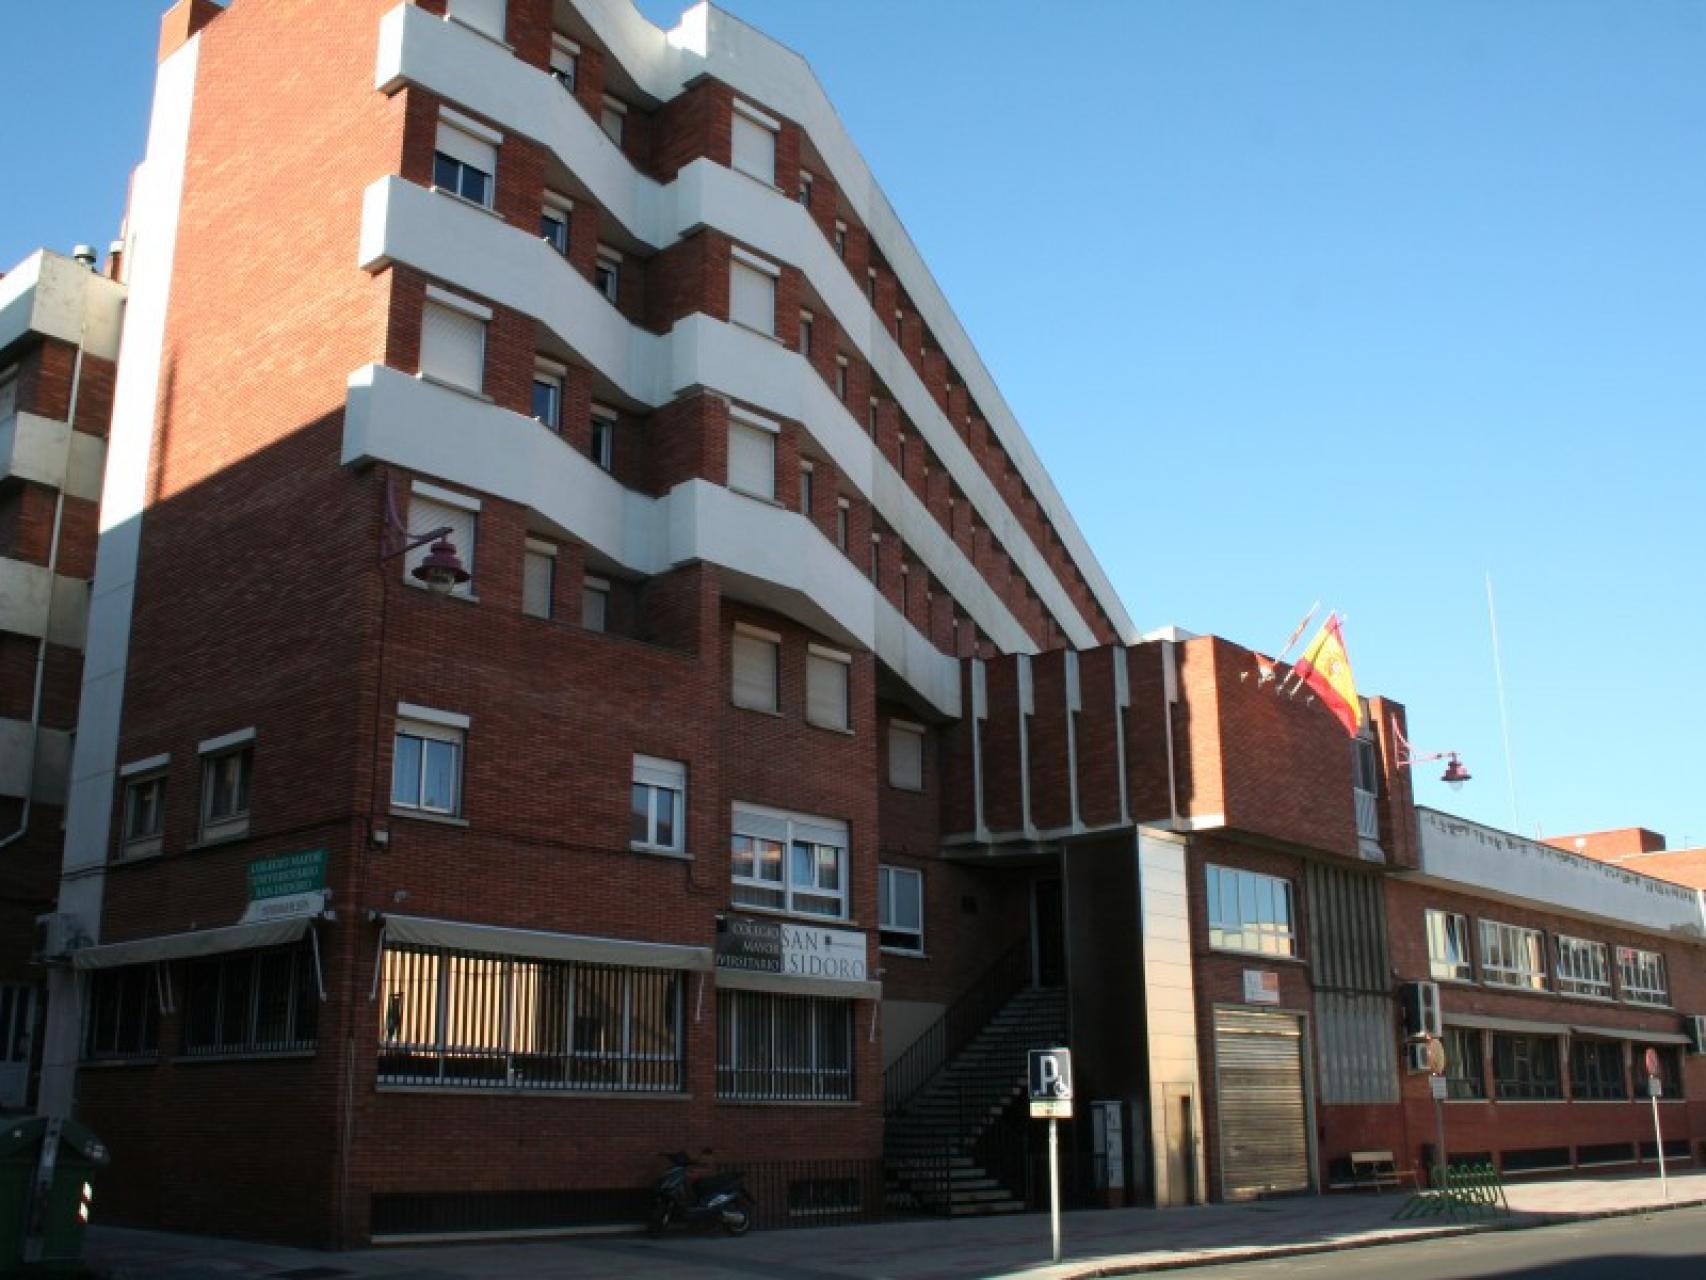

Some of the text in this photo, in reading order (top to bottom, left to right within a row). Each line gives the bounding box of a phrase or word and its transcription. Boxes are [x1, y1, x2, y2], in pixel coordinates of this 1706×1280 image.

[732, 922, 779, 939] COLEGIO
[782, 926, 818, 951] SAN
[743, 940, 779, 954] MAYOR
[1040, 1055, 1058, 1095] P
